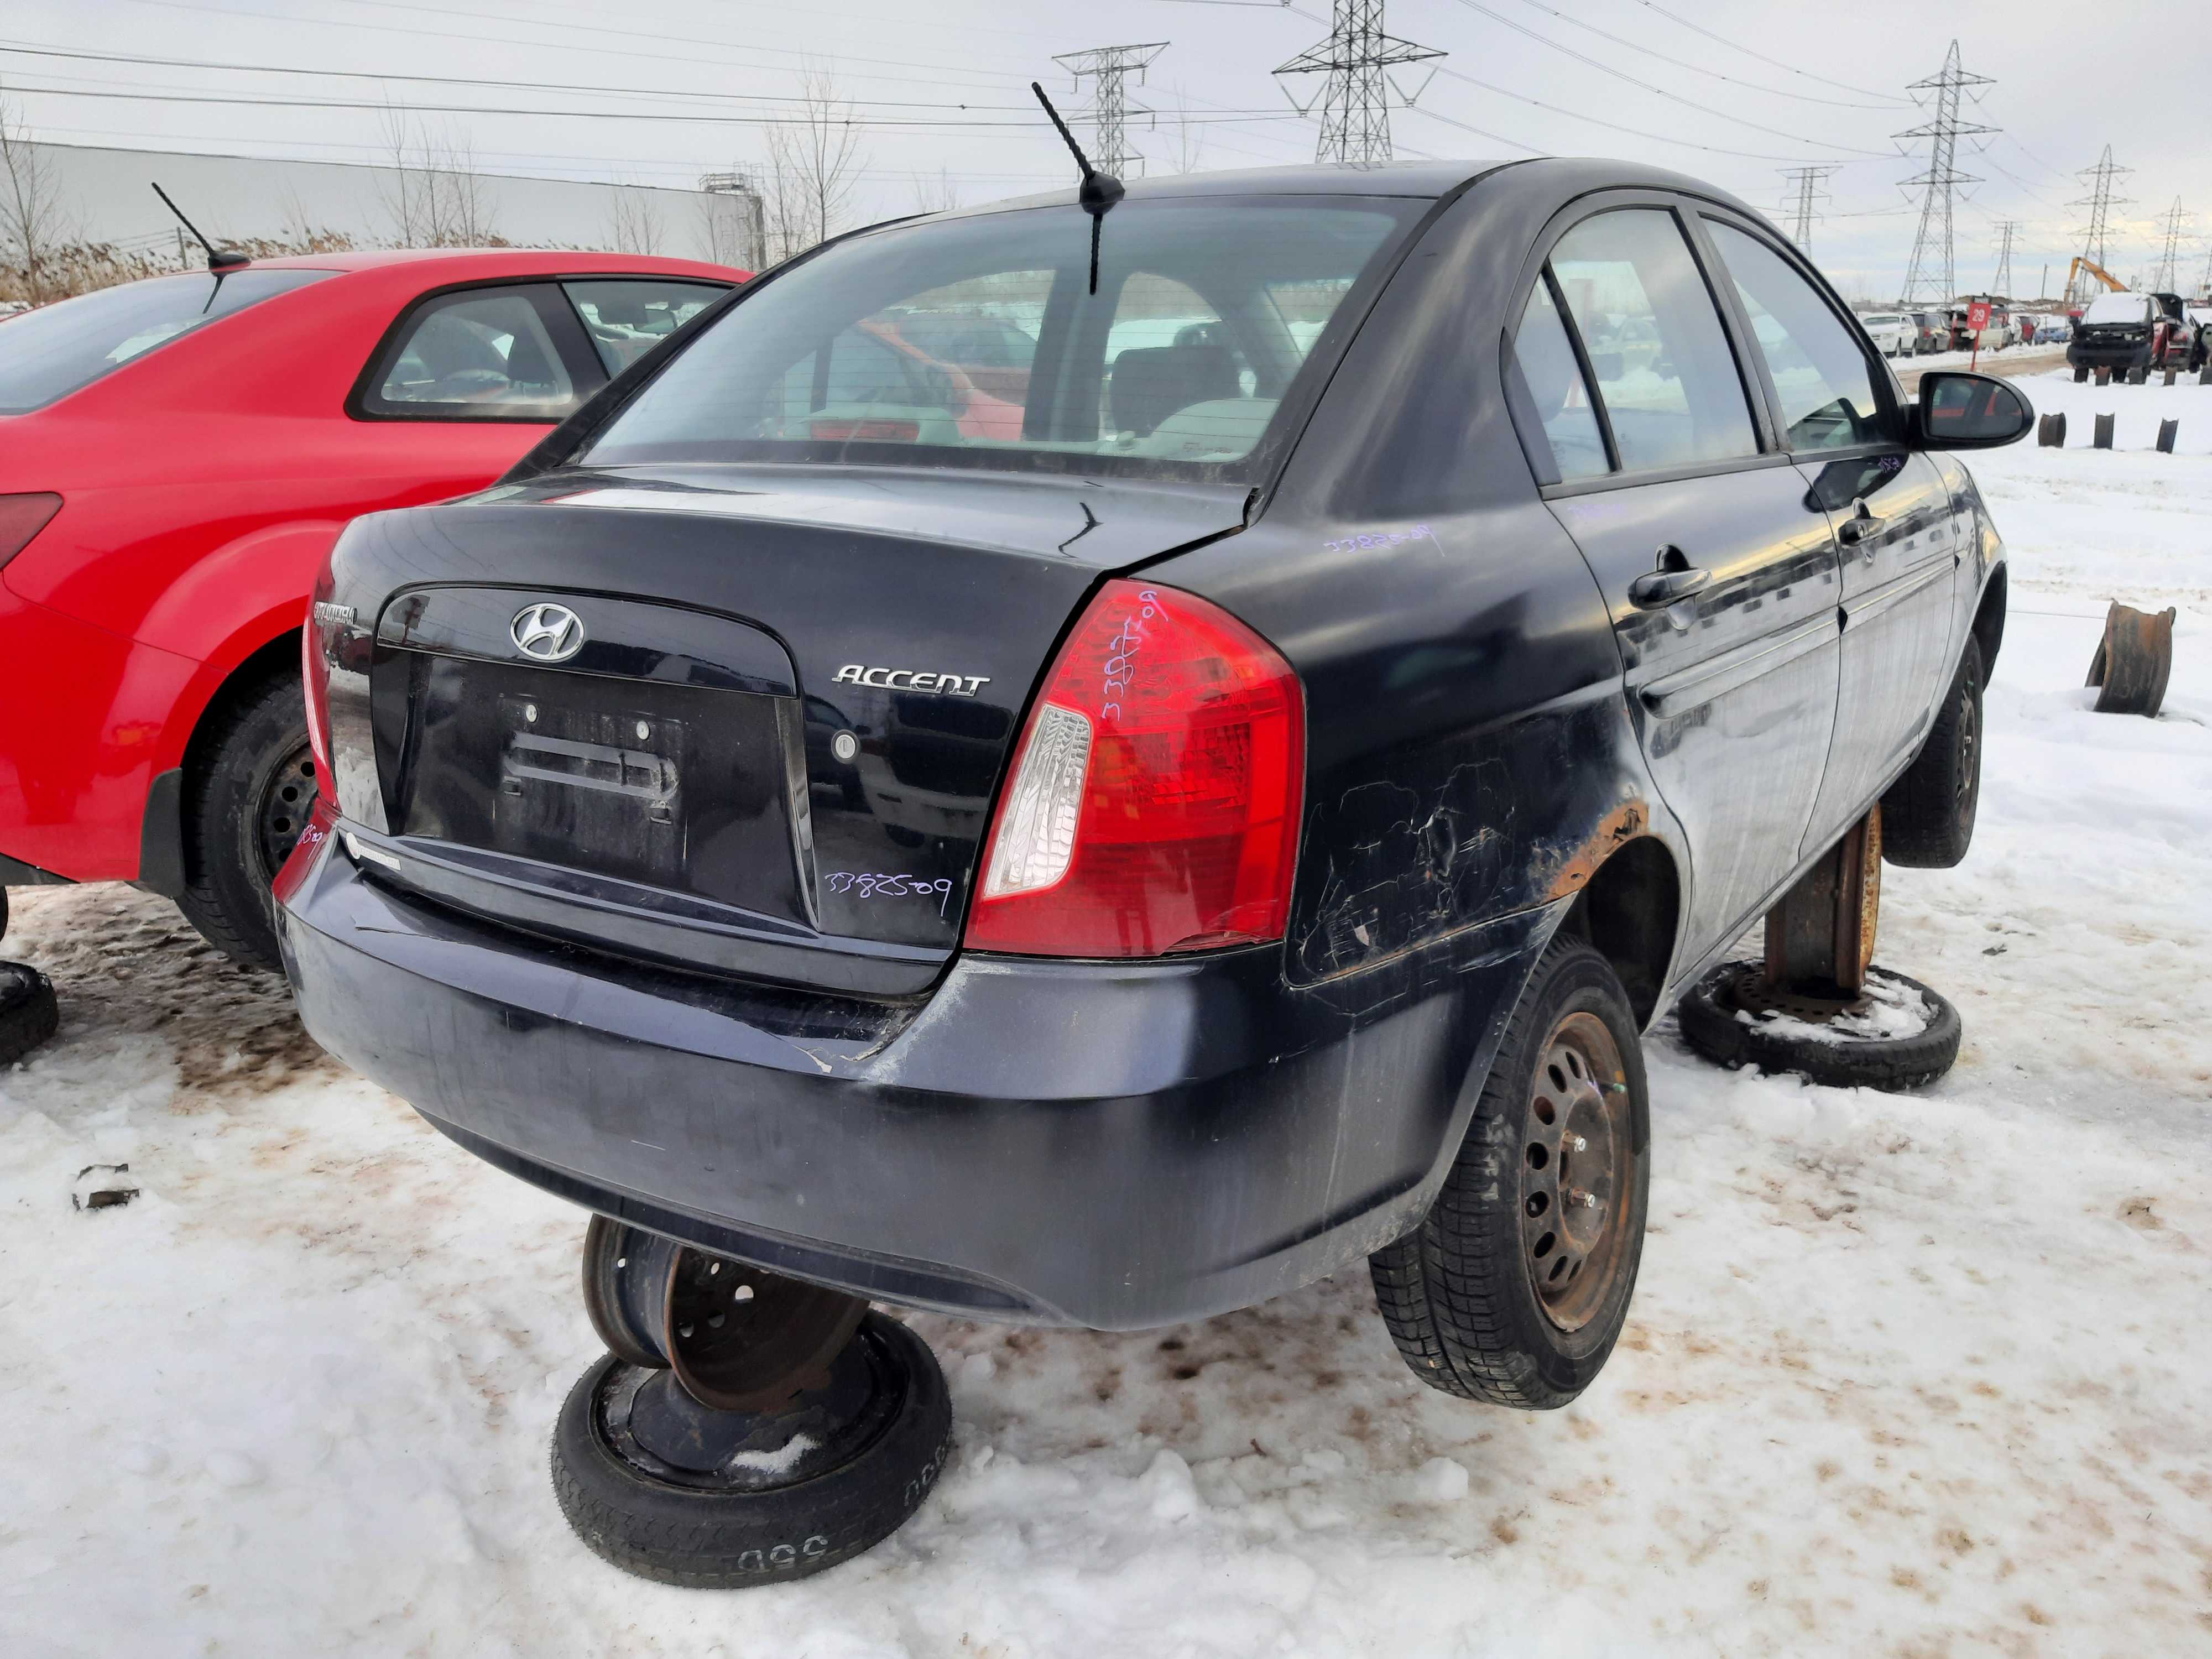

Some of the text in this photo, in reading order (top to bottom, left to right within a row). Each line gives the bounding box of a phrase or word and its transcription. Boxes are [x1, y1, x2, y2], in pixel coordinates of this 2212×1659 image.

[1972, 308, 1985, 322] 29
[832, 665, 991, 697] ACCENT
[825, 872, 953, 917] 33825-09
